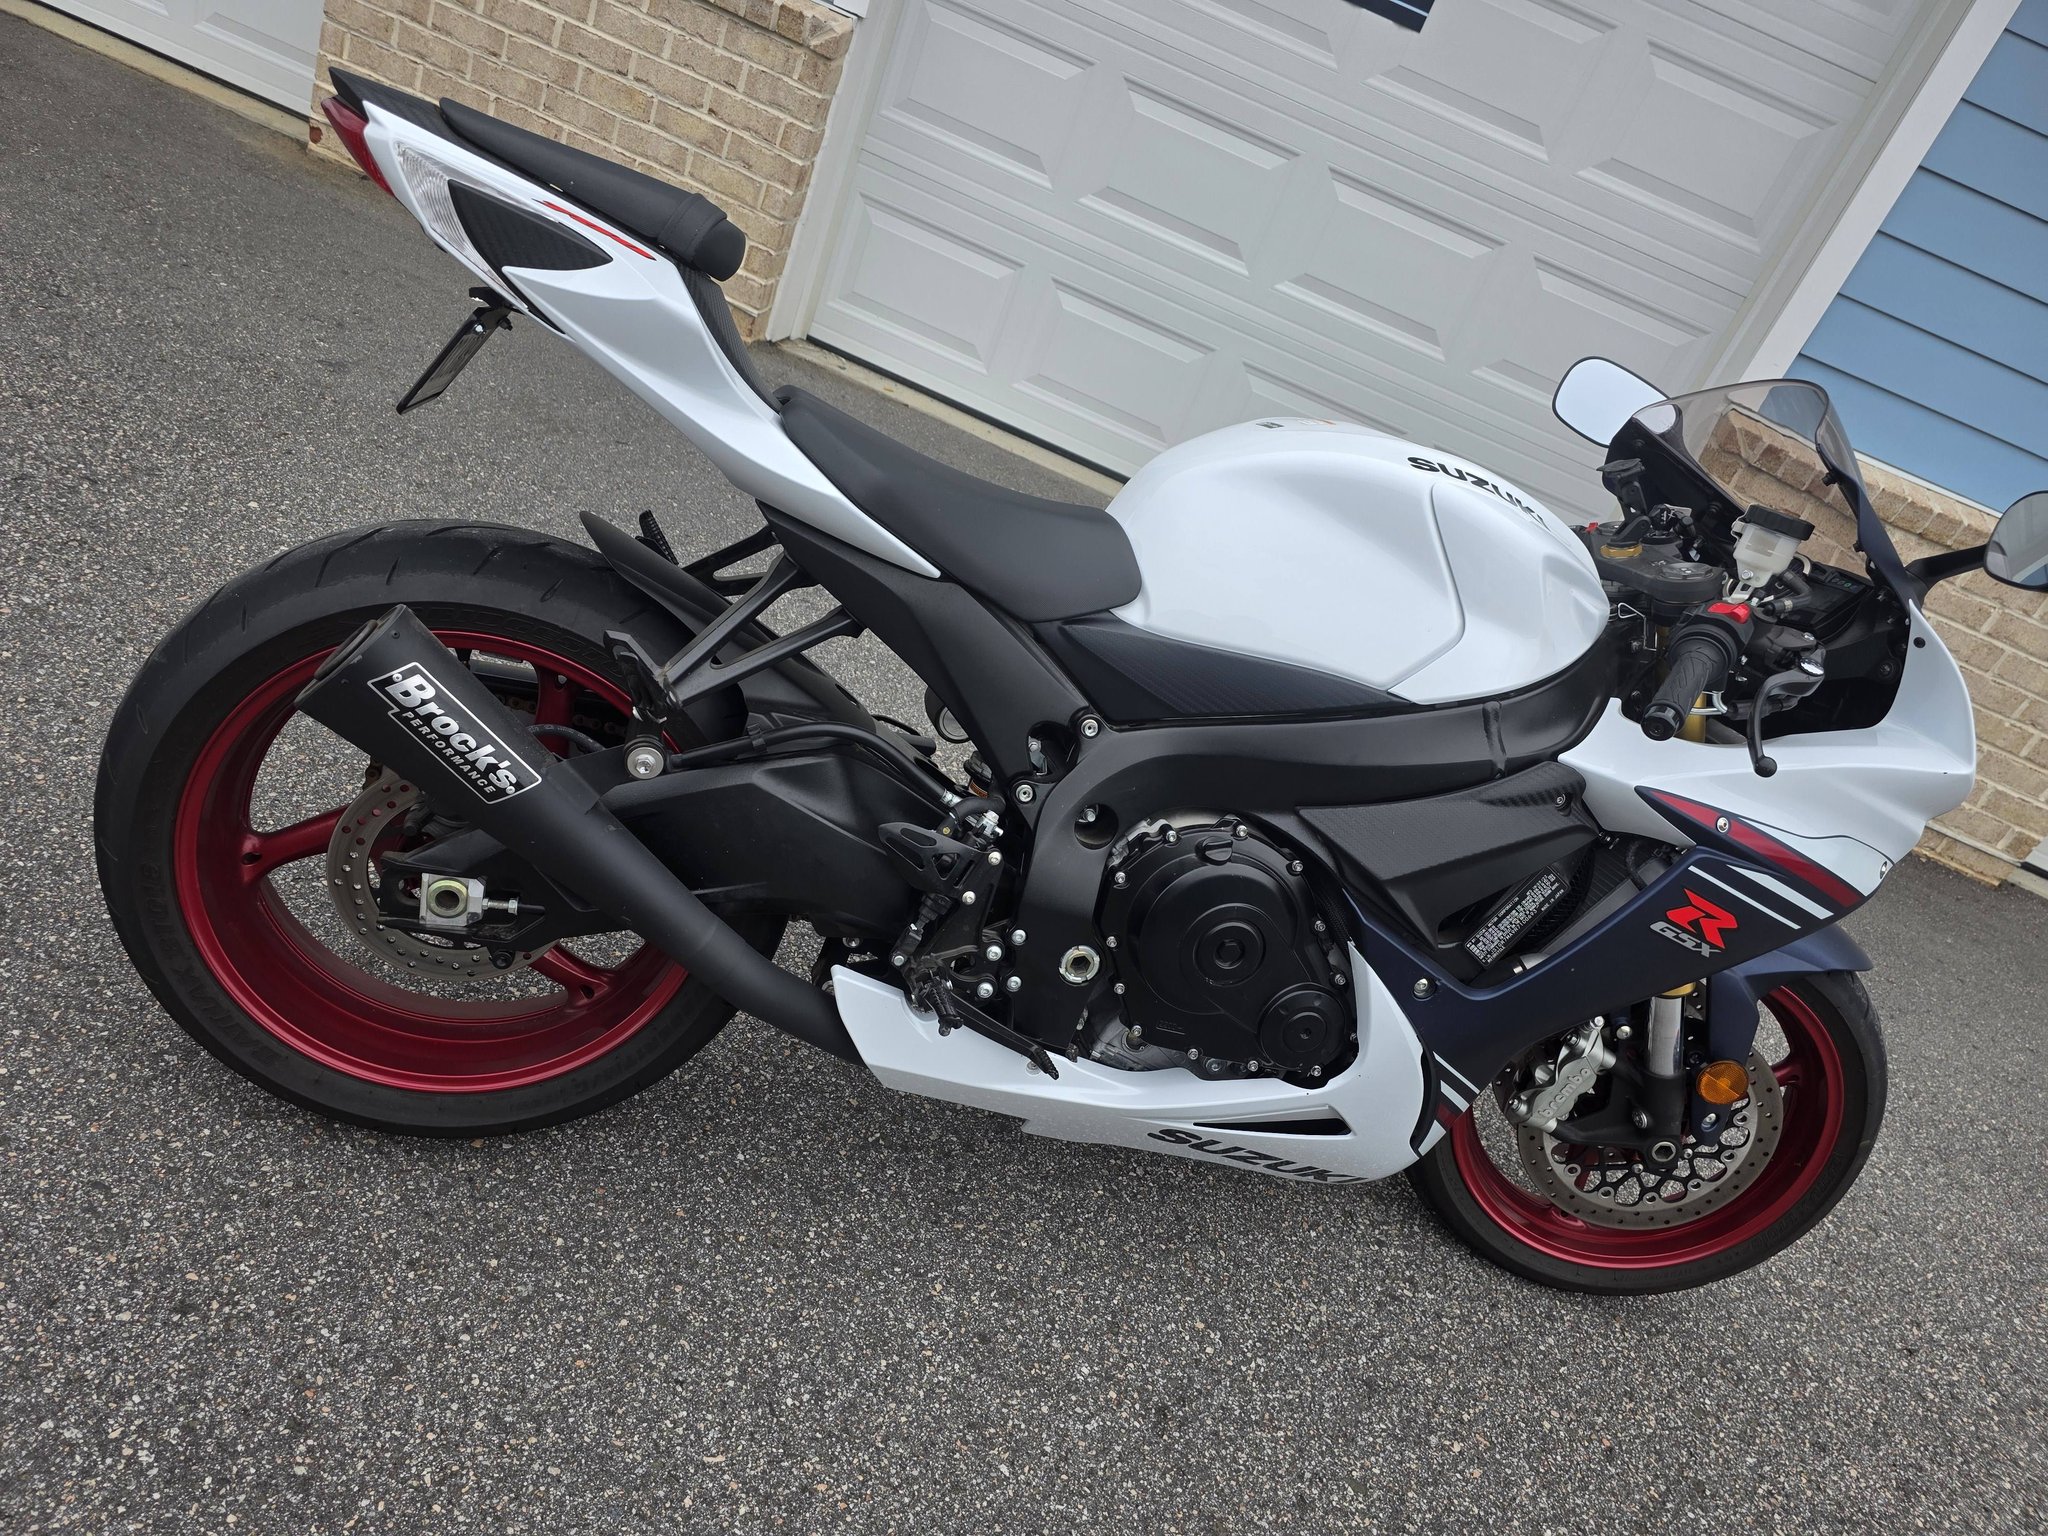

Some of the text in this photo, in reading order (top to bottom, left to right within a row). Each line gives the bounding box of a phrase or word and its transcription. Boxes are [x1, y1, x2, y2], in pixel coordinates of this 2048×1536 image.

[1407, 456, 1552, 532] SUZUKI
[385, 674, 517, 788] Brock's
[402, 711, 496, 794] PERFORMANCE
[1650, 920, 1722, 958] GSX
[1666, 887, 1738, 950] R
[1537, 1067, 1591, 1118] brembo
[1146, 1128, 1369, 1184] SUZUKI
